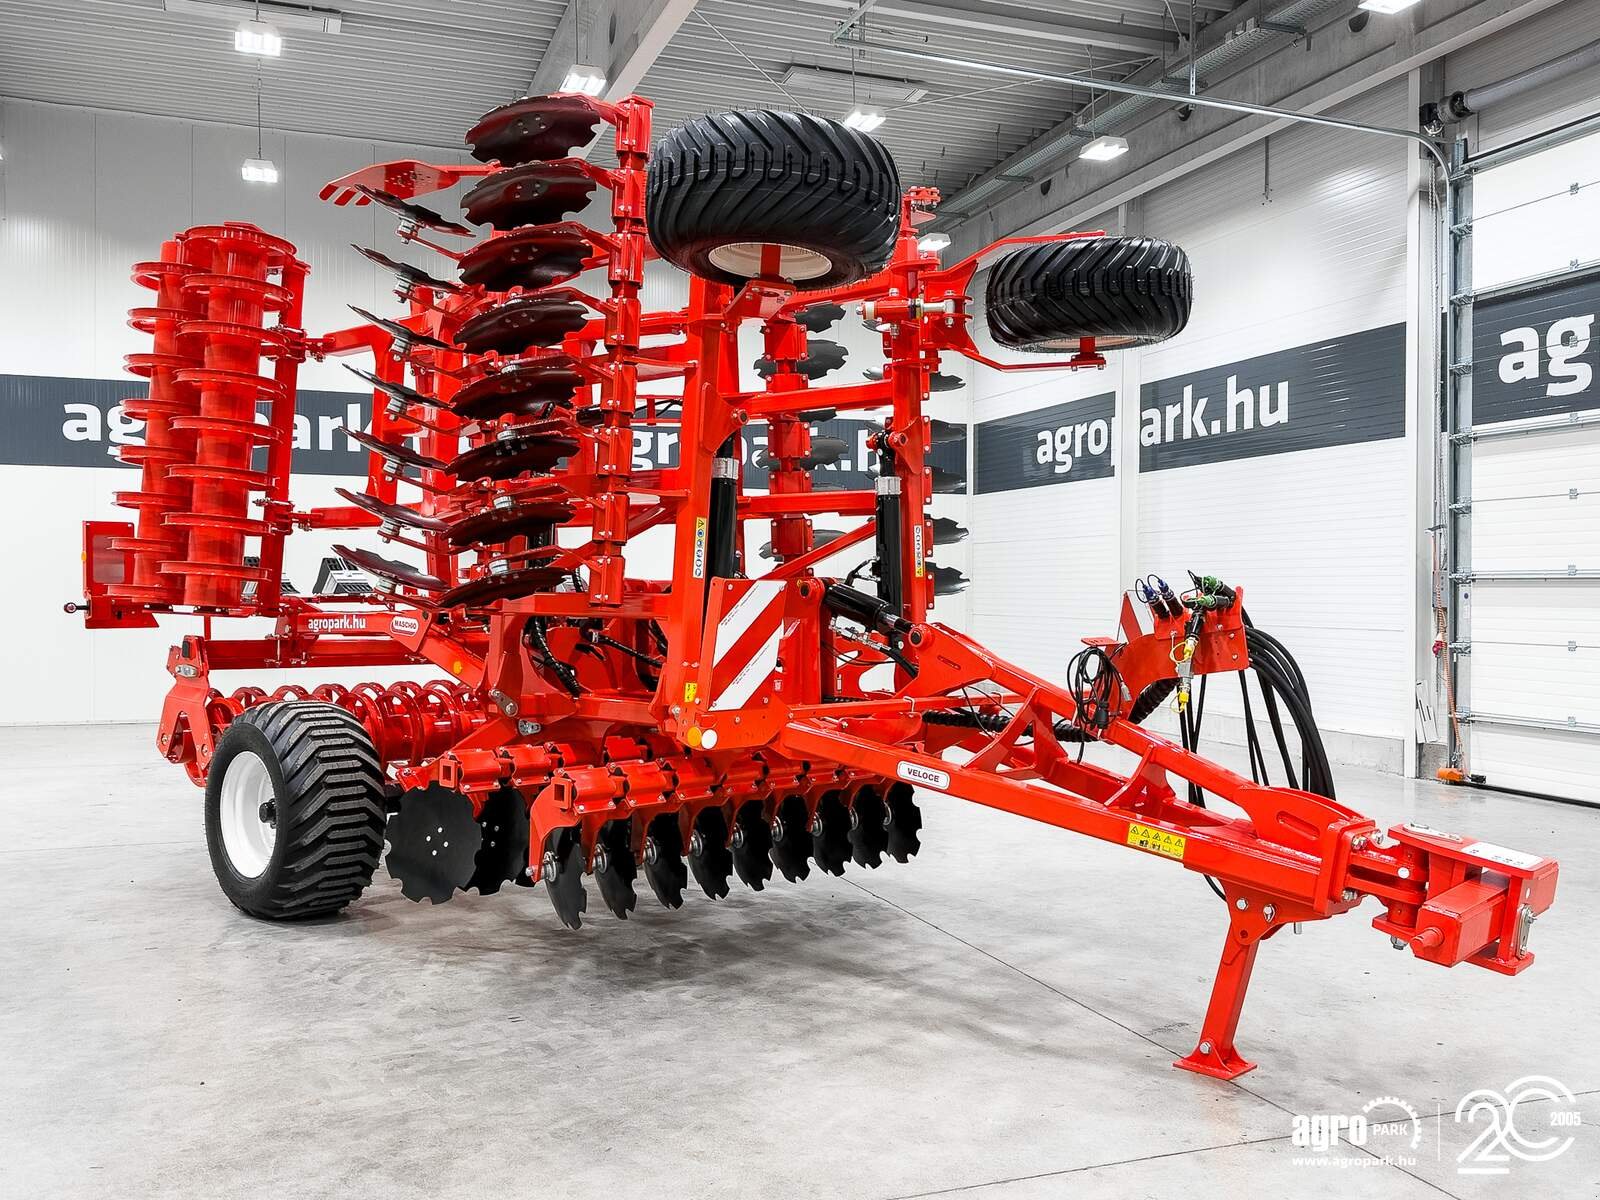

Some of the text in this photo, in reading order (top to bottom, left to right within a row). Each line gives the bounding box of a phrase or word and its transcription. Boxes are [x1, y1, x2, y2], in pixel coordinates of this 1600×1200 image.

[1036, 374, 1289, 474] agroark.hu
[308, 614, 366, 633] agropark.hu
[907, 767, 940, 783] VELOCE
